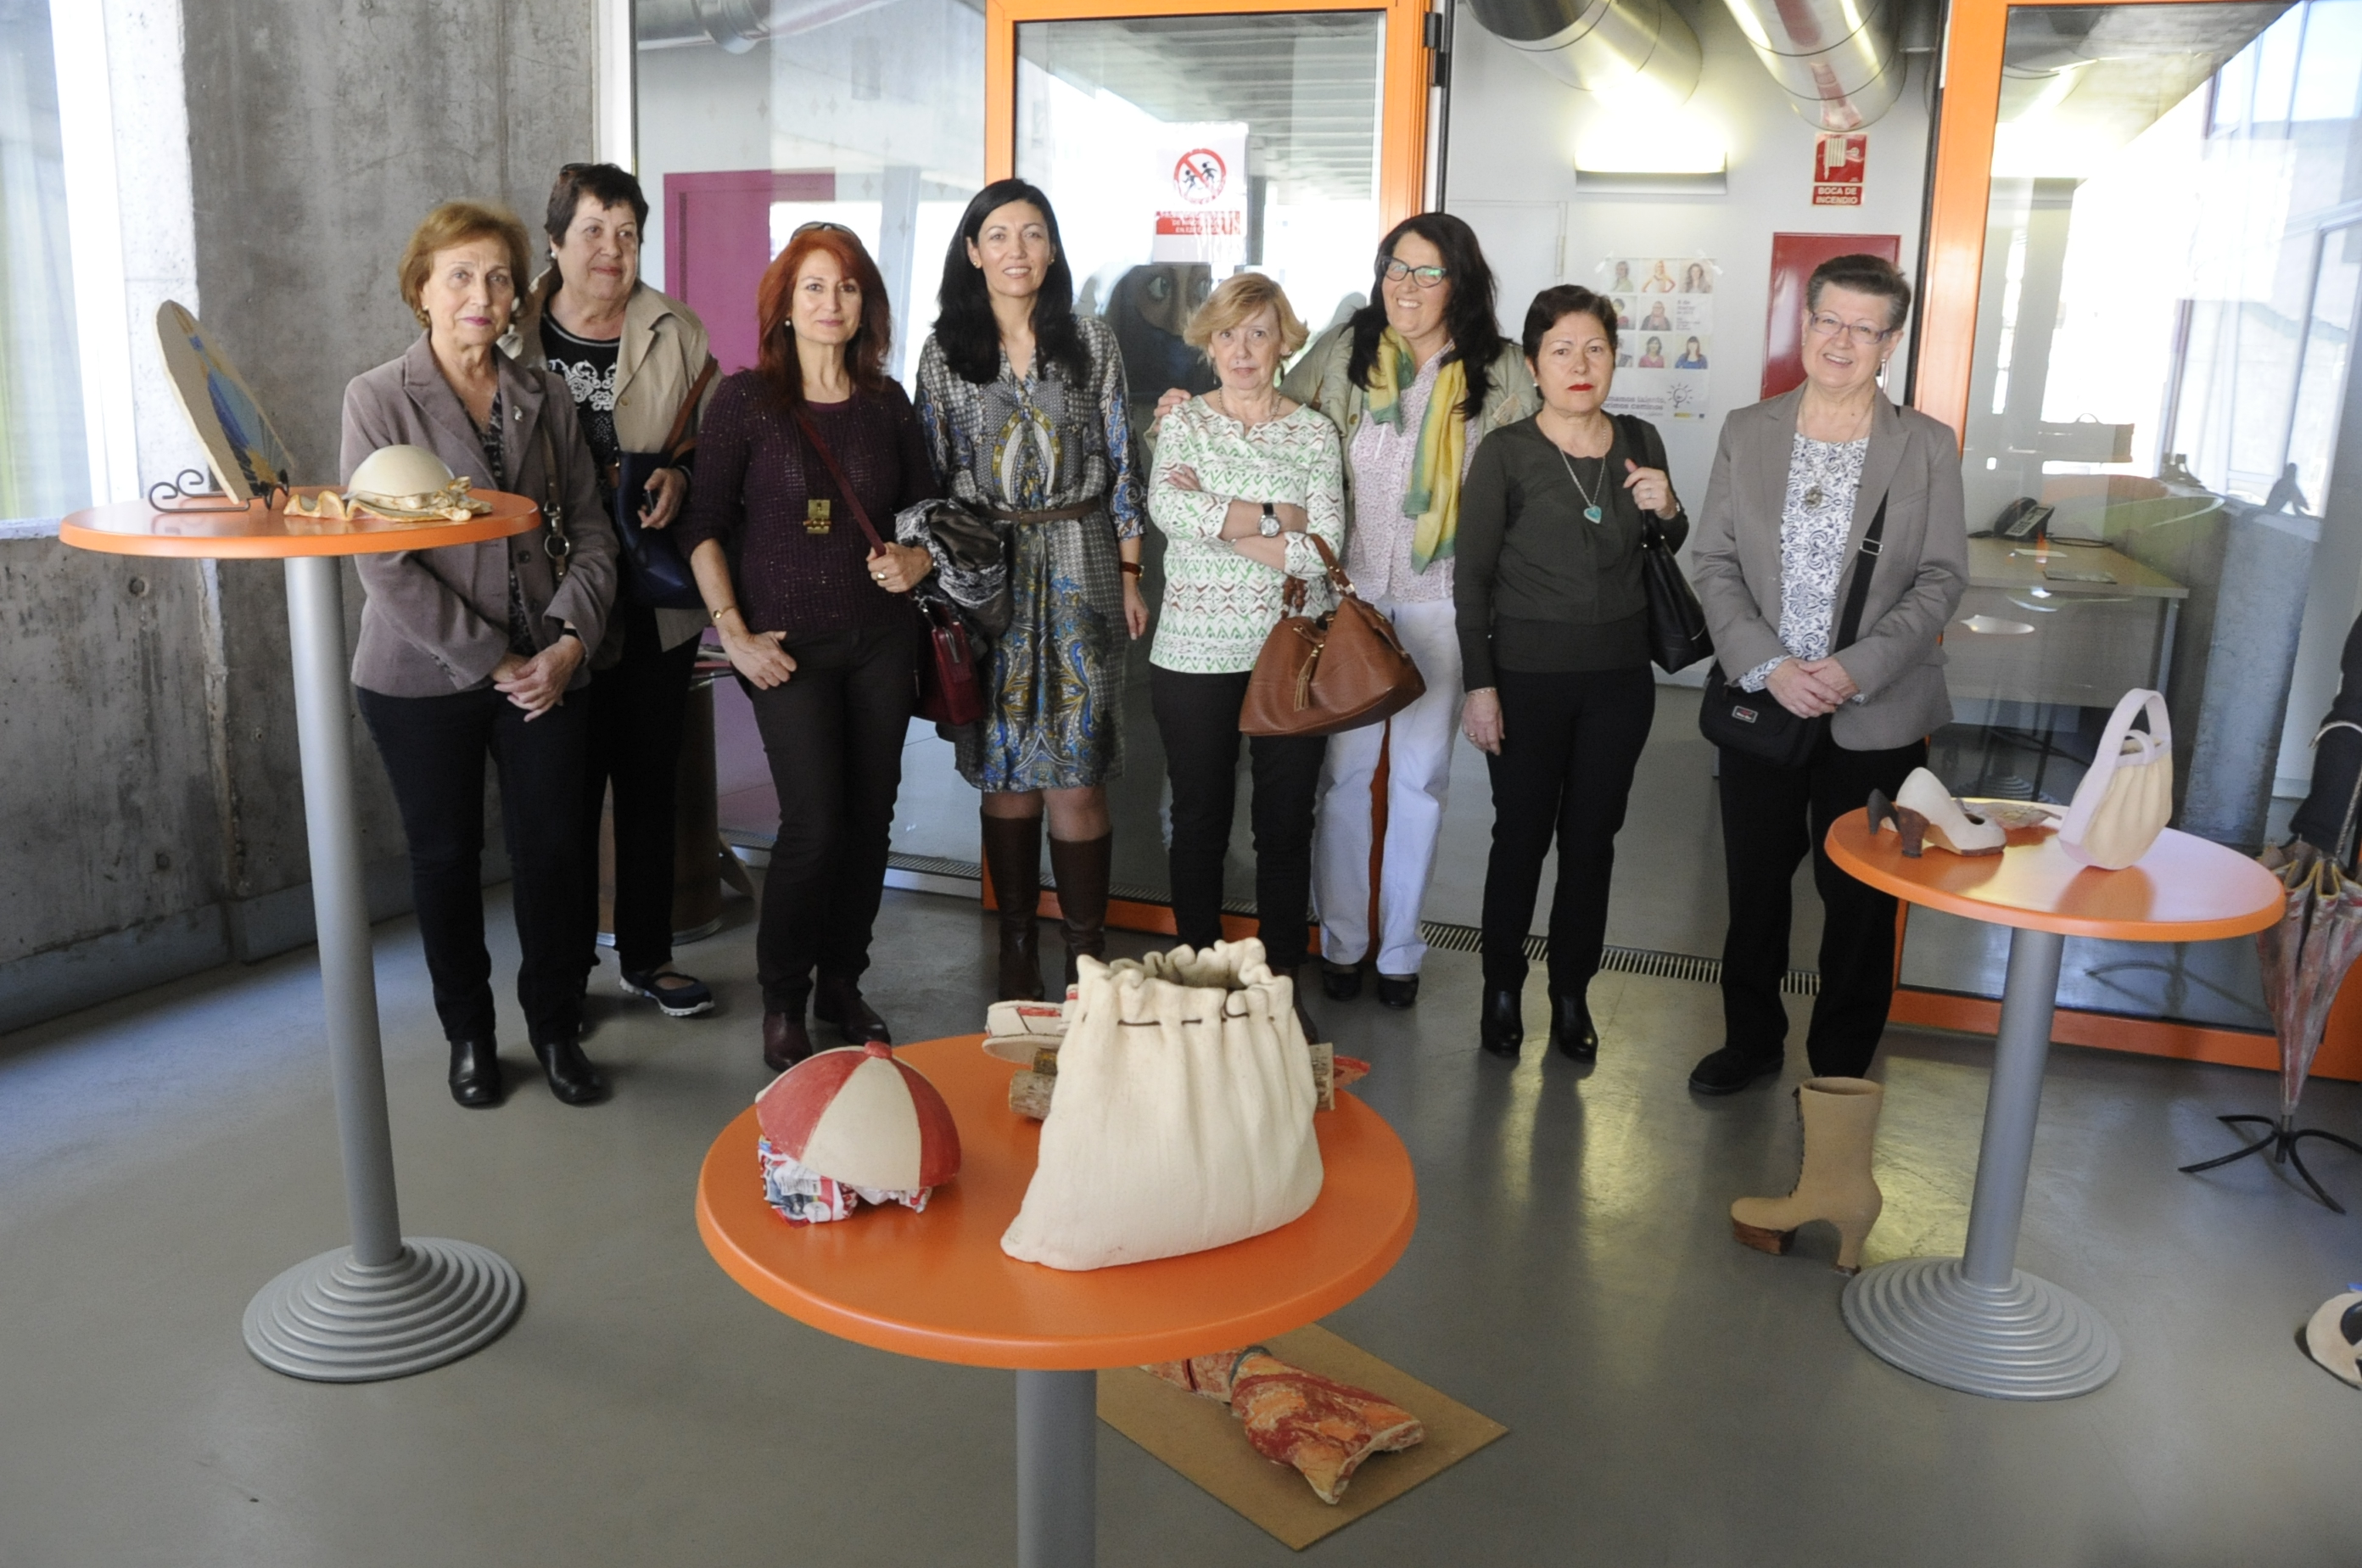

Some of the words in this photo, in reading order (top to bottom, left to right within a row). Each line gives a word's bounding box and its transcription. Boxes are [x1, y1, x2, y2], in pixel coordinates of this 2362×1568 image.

[1817, 187, 1844, 195] BOCA
[1844, 187, 1857, 195] DE
[1816, 196, 1859, 204] INCENDIO
